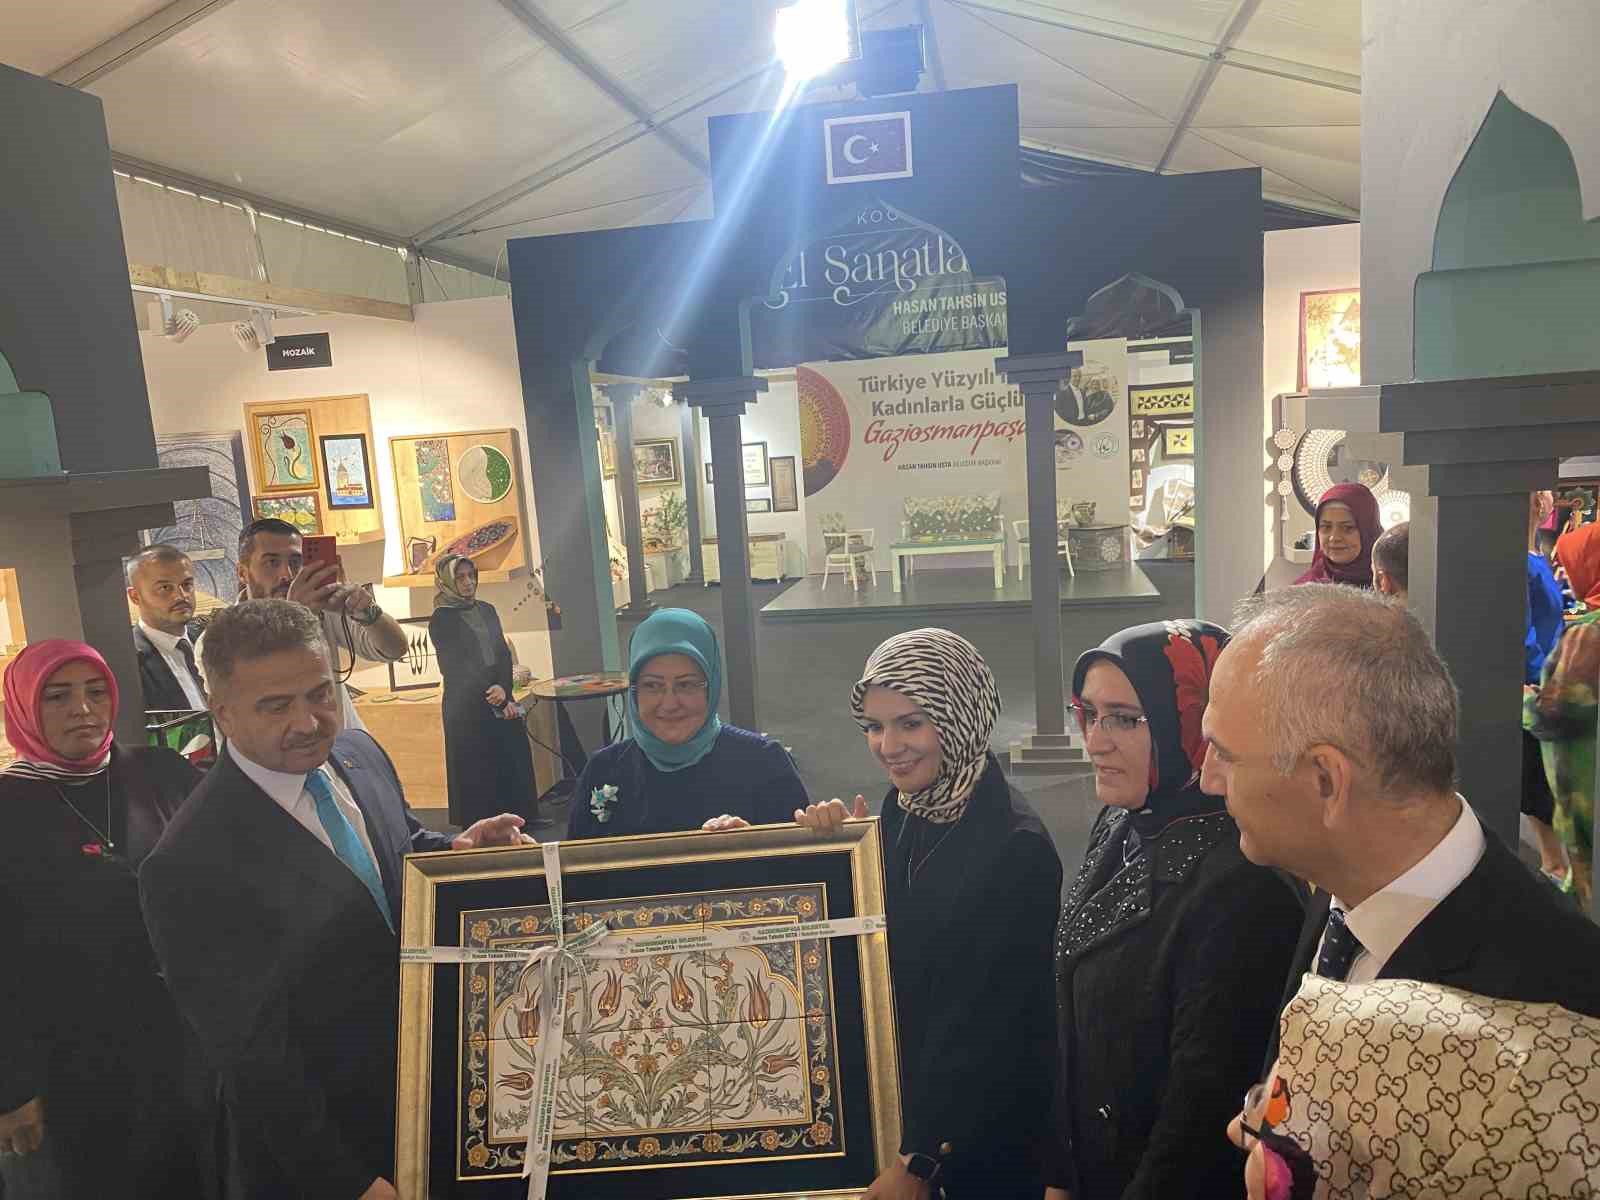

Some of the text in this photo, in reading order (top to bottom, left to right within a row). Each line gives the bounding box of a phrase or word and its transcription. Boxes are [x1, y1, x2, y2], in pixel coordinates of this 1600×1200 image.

[893, 297, 938, 316] HASAN
[858, 373, 927, 394] Türkiye
[871, 391, 1024, 416] Kadınlarla Güçlü
